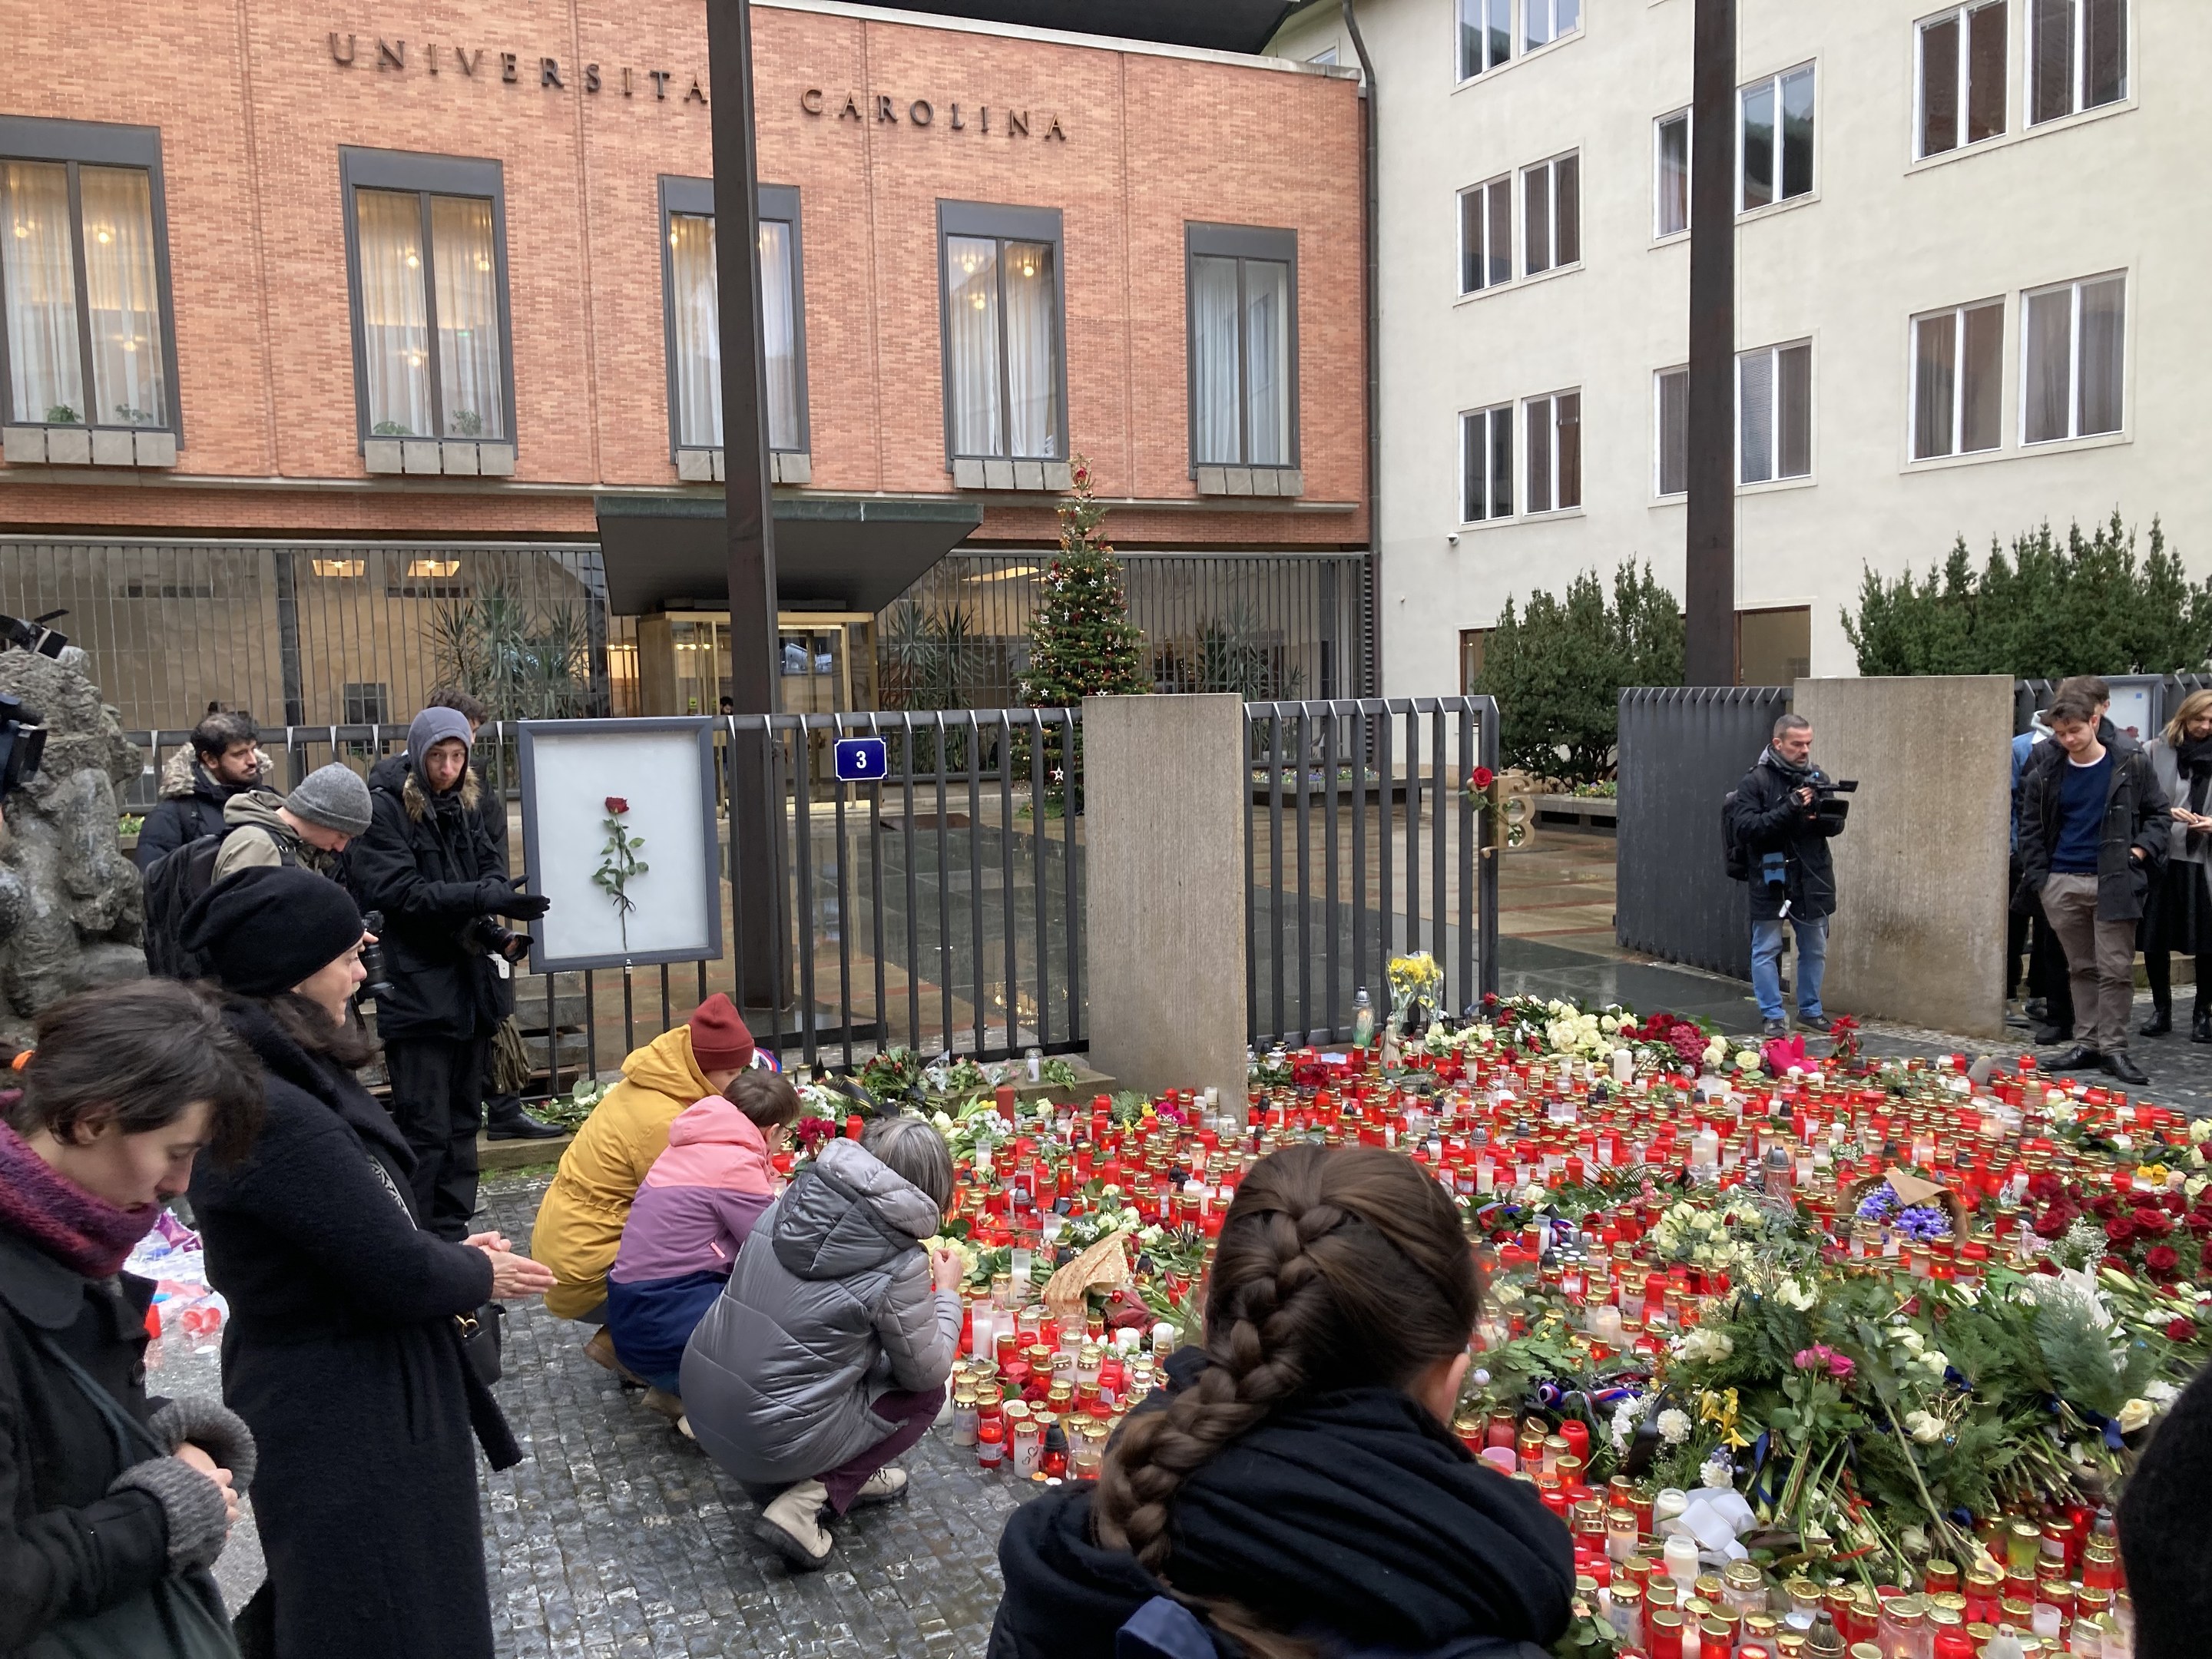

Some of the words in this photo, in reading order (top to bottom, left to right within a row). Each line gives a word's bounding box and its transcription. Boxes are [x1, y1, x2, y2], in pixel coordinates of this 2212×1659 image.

[329, 31, 709, 104] UNIVERSITA
[800, 88, 1068, 141] CAROLINA
[856, 750, 867, 769] 3
